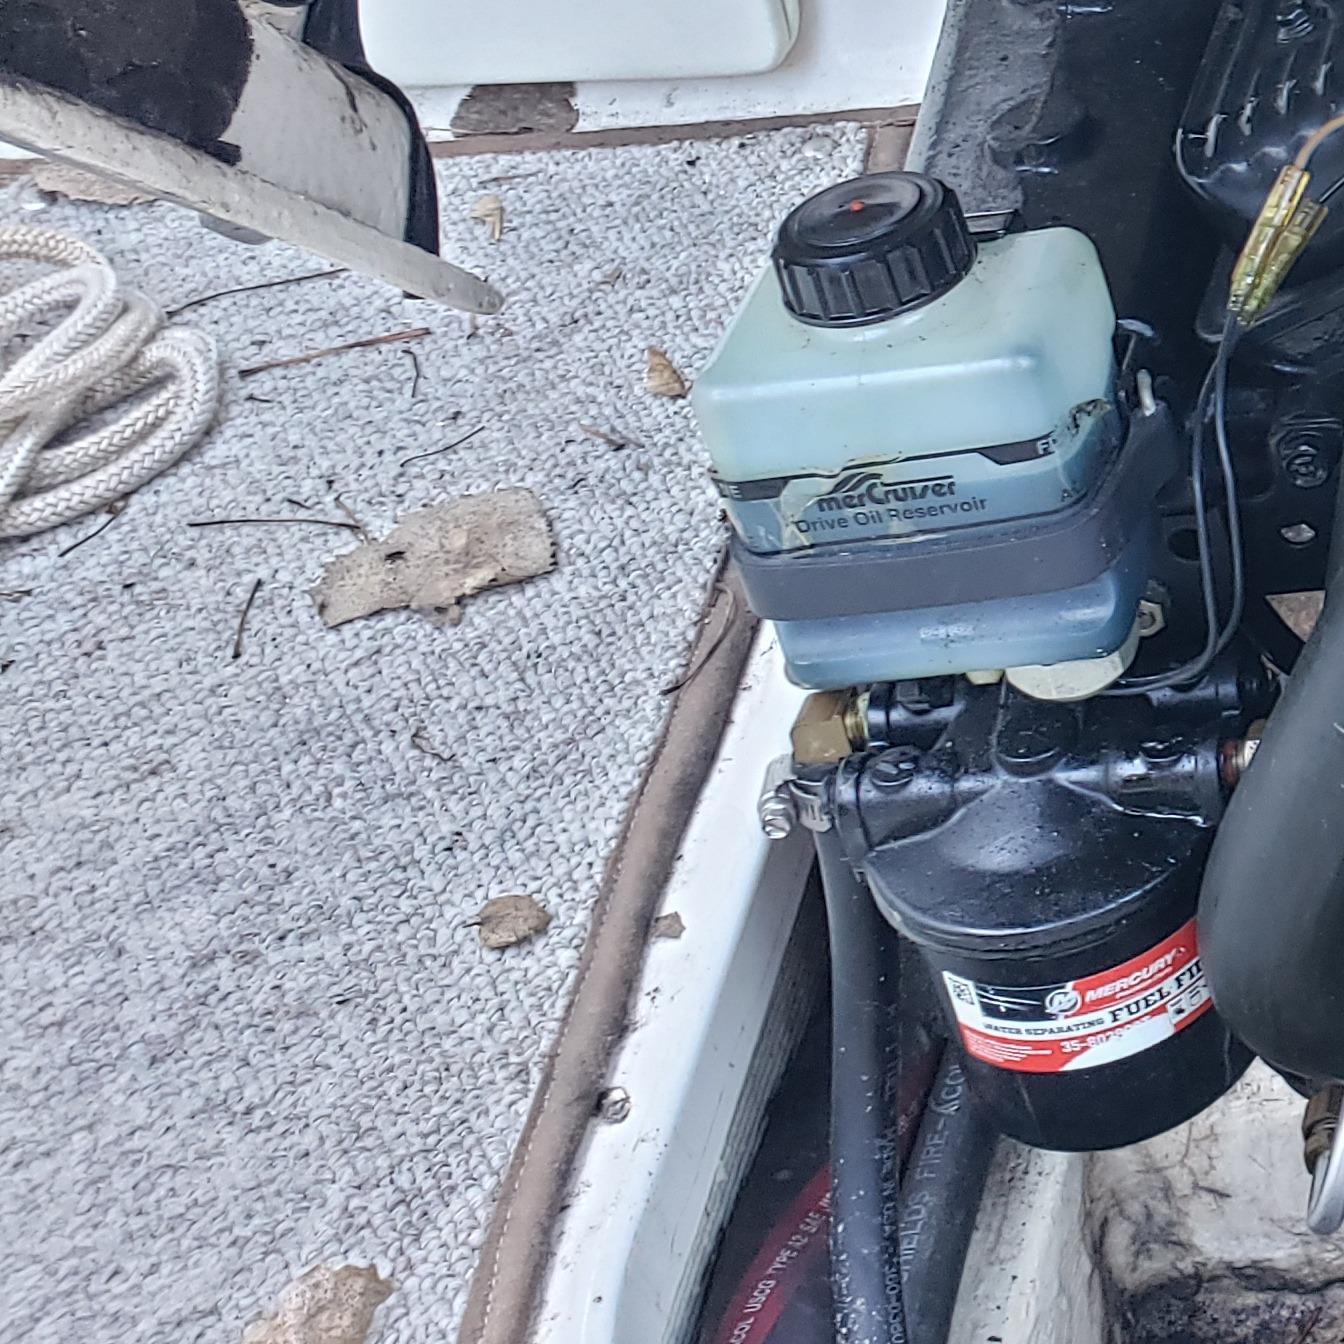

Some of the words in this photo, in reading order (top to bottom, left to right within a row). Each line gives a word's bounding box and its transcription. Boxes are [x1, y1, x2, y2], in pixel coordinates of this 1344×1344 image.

[795, 517, 849, 534] Drive
[853, 510, 883, 526] Oil
[889, 496, 988, 523] Reservoir
[1084, 947, 1178, 1003] MERCURY
[1025, 1017, 1105, 1035] SEPARATING
[1108, 987, 1172, 1023] FUEL
